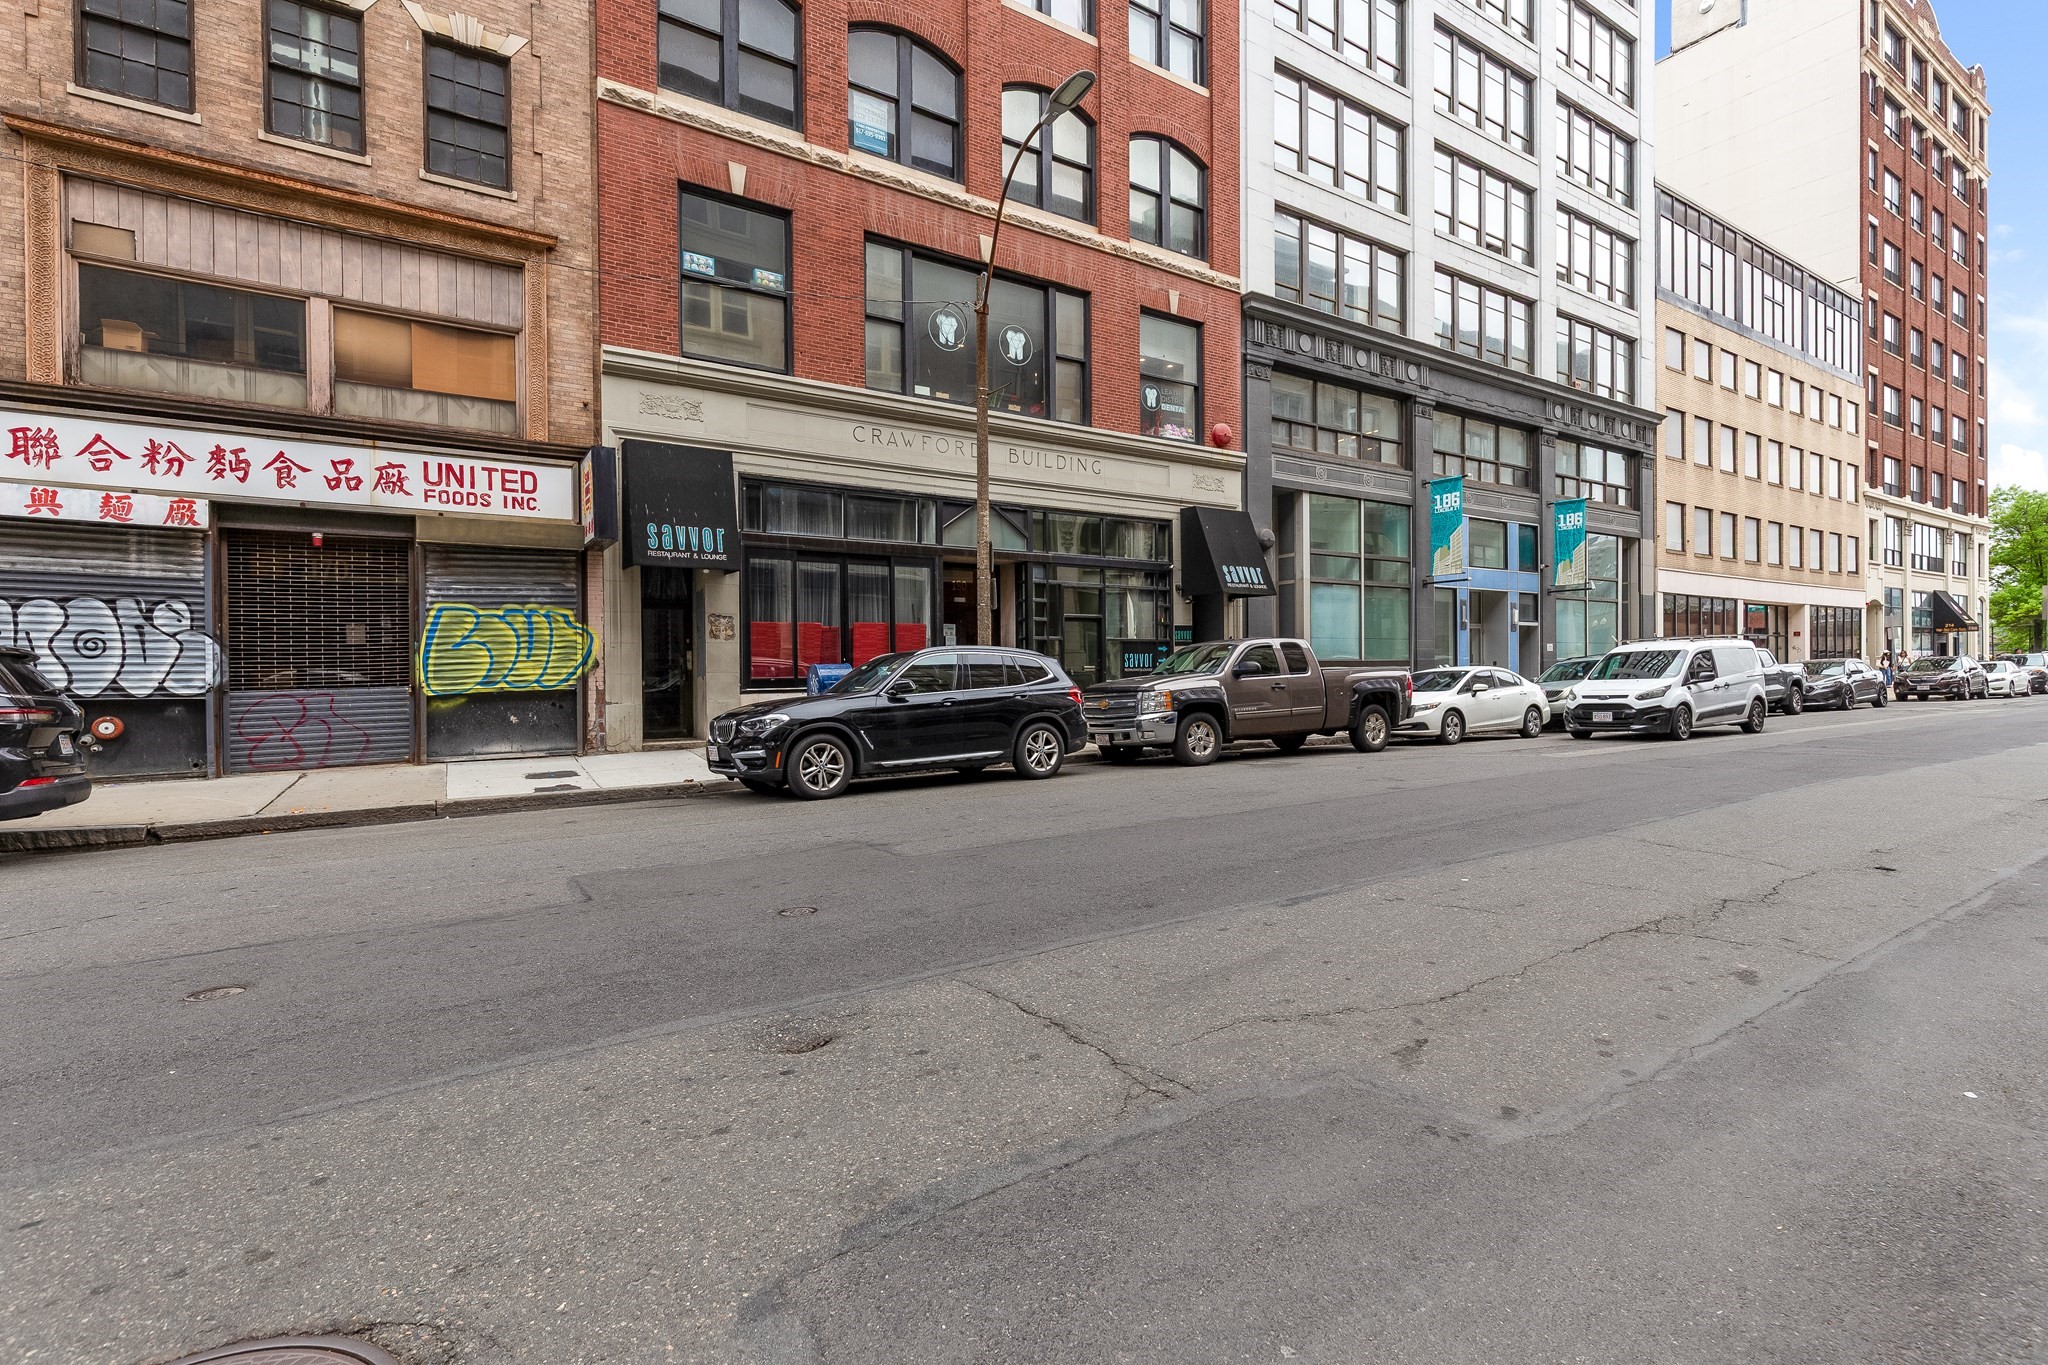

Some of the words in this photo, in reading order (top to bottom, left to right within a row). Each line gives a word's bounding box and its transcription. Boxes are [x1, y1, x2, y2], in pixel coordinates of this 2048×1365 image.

[1161, 403, 1186, 414] DENTAL
[1009, 447, 1101, 475] BUILDING
[423, 461, 538, 495] UNITED
[423, 488, 492, 508] FOODS
[503, 495, 541, 512] INC.
[1434, 491, 1461, 509] 186
[1558, 511, 1583, 527] 186
[646, 522, 725, 553] savvor
[647, 550, 691, 559] RESTAURANT
[700, 553, 728, 561] LOUNGE
[1222, 564, 1264, 584] savvor
[1124, 653, 1153, 668] savvor
